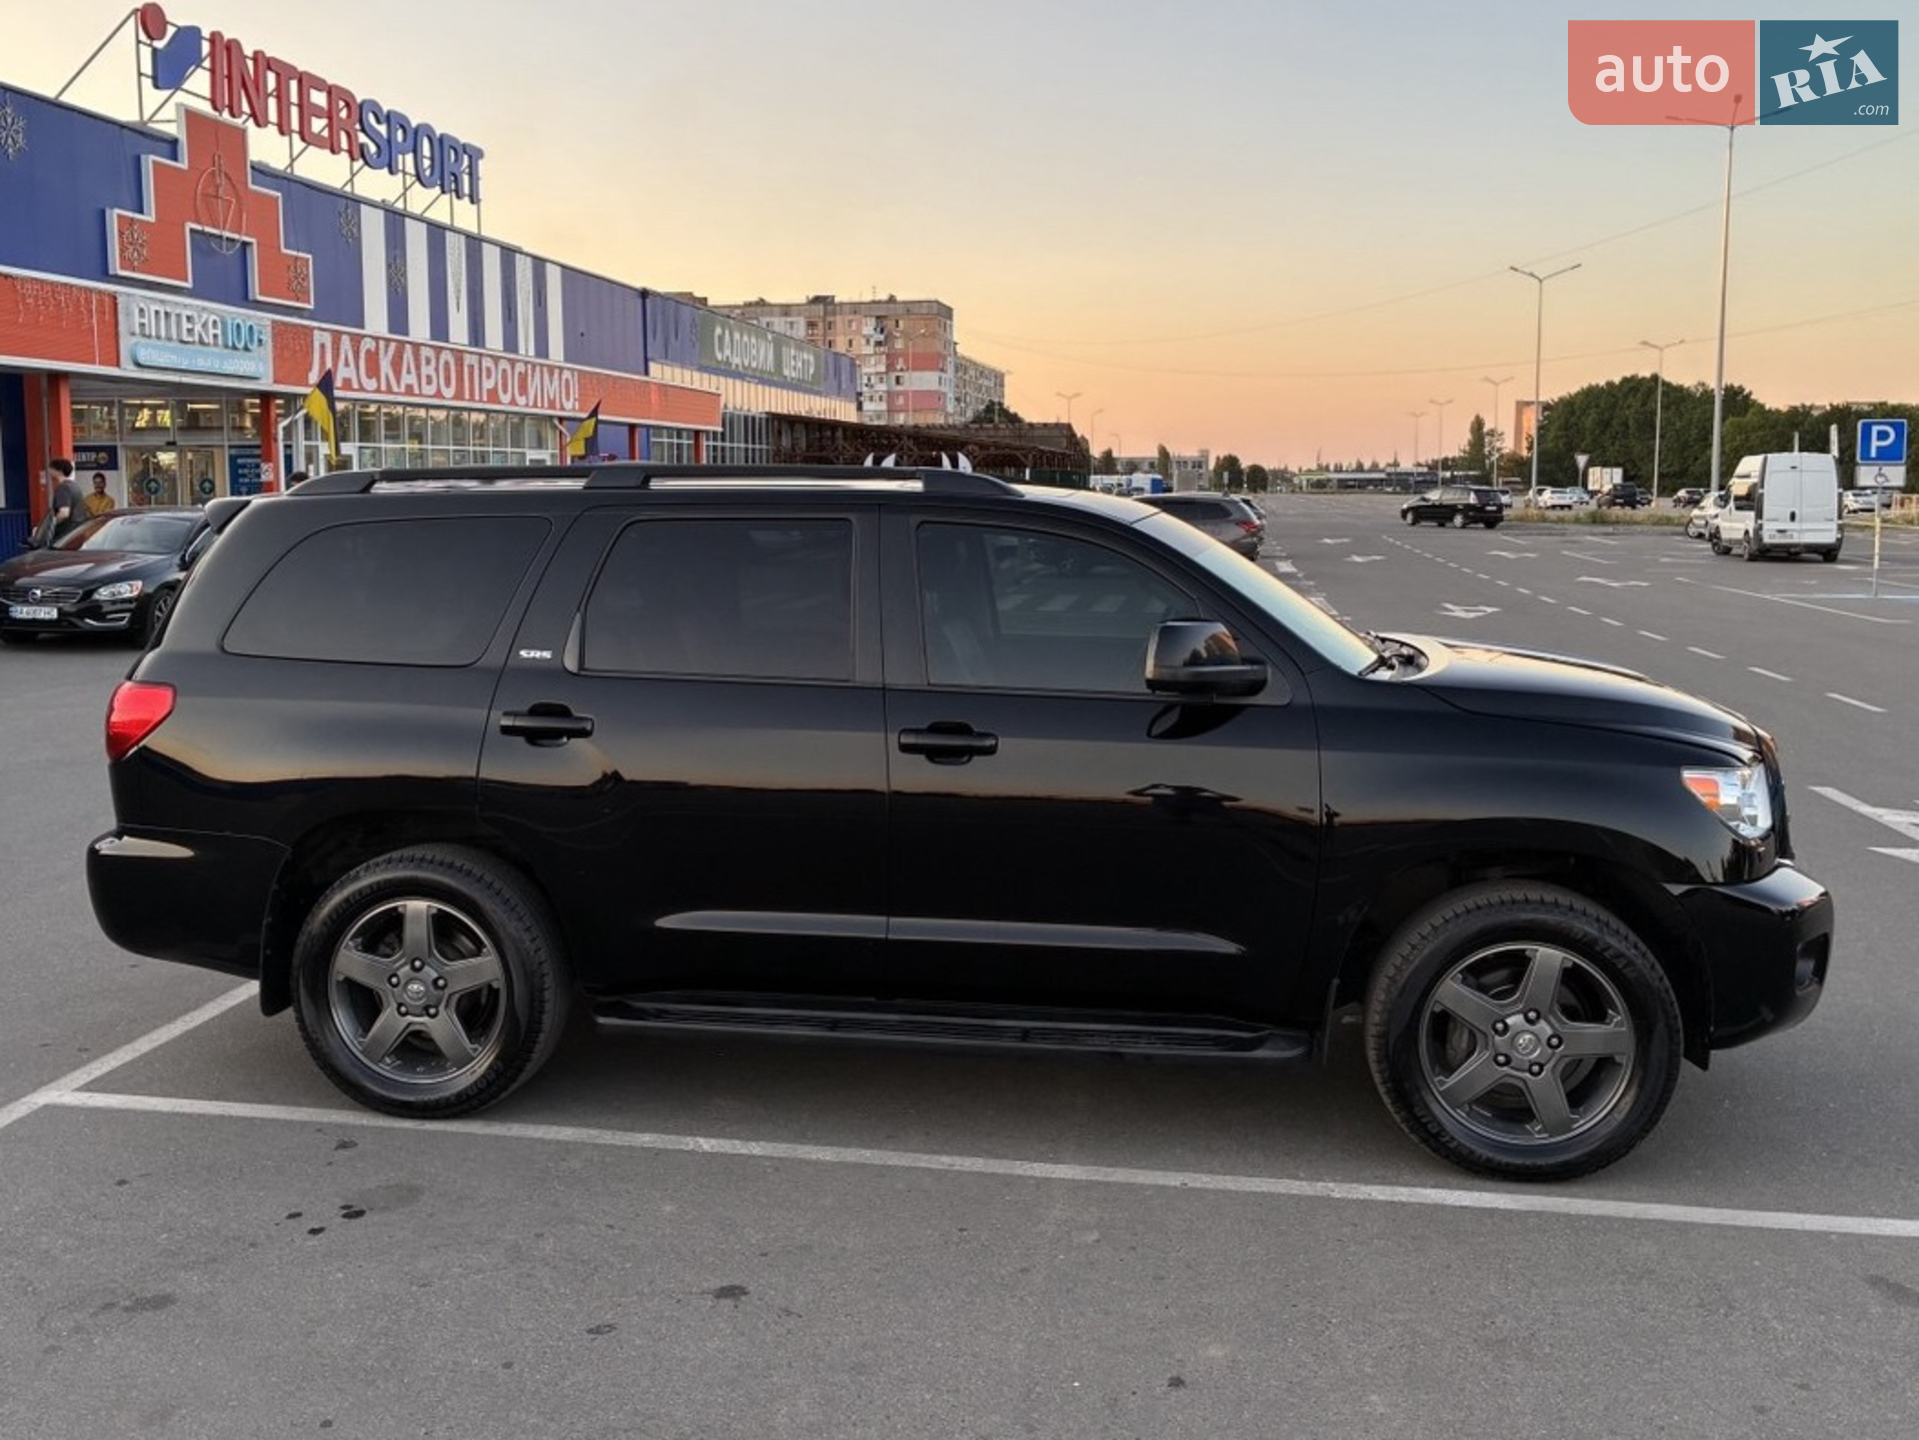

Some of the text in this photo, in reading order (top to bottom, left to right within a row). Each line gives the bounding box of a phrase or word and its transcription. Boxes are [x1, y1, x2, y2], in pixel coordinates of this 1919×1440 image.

[209, 30, 484, 204] INTERSPORT
[134, 303, 222, 346] АПТЕКА
[308, 329, 579, 410] ЛАСКАВО ПРОСИМО!
[714, 325, 815, 381] САДОВИЙ ЦЕНТР
[1870, 425, 1896, 458] P
